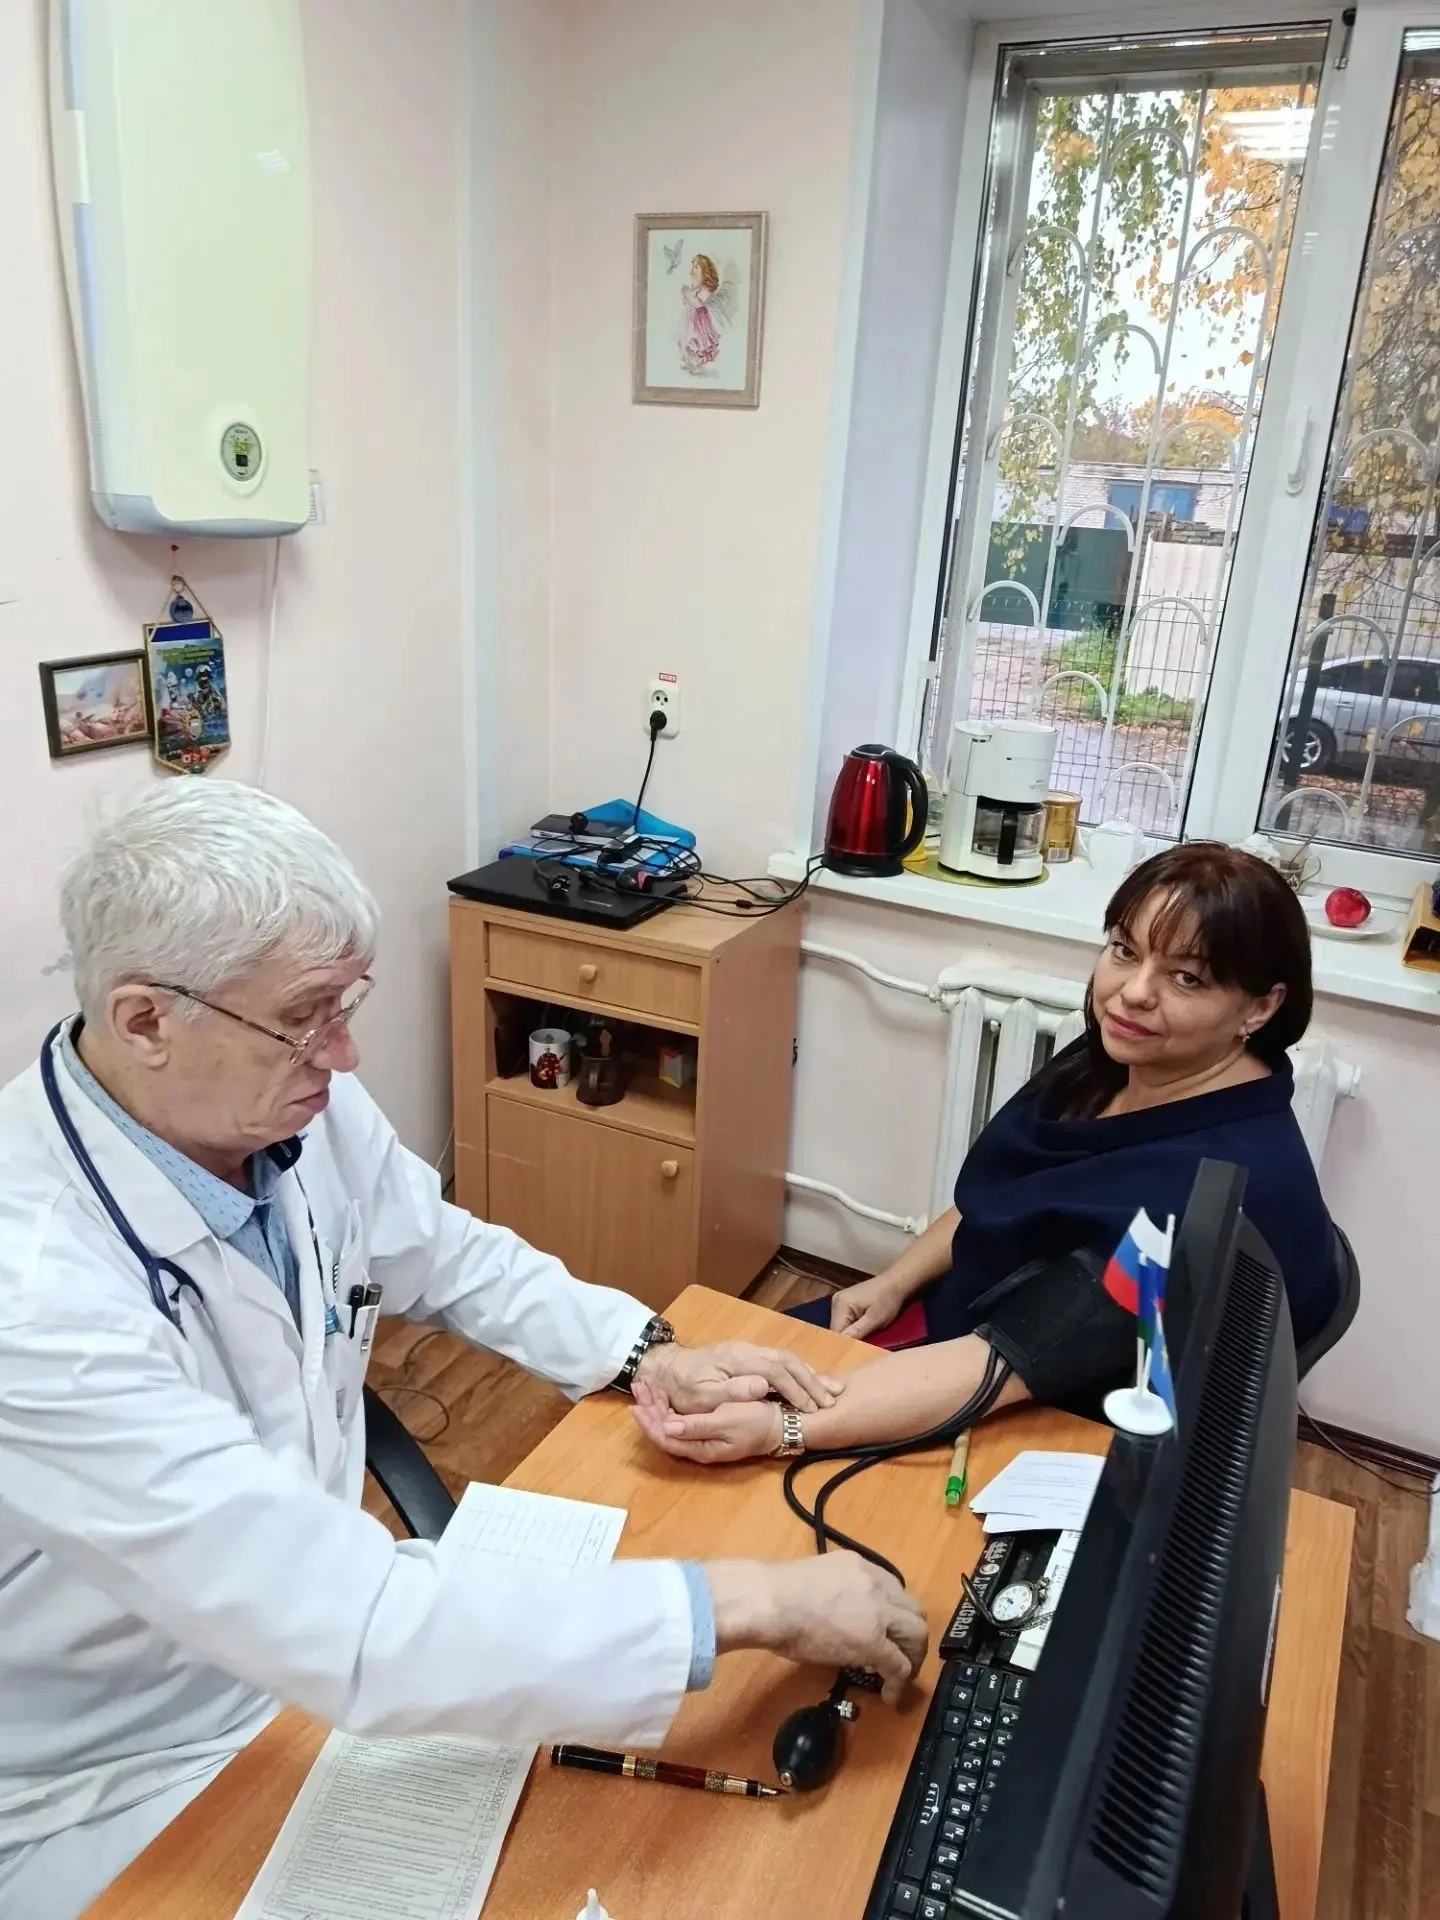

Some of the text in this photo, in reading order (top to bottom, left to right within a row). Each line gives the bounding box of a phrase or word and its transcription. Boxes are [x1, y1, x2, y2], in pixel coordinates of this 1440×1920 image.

[949, 1576, 991, 1638] LENGRAD
[951, 1807, 960, 1815] И
[955, 1827, 965, 1836] N
[931, 1882, 941, 1890] Б
[924, 1906, 935, 1917] Ю
